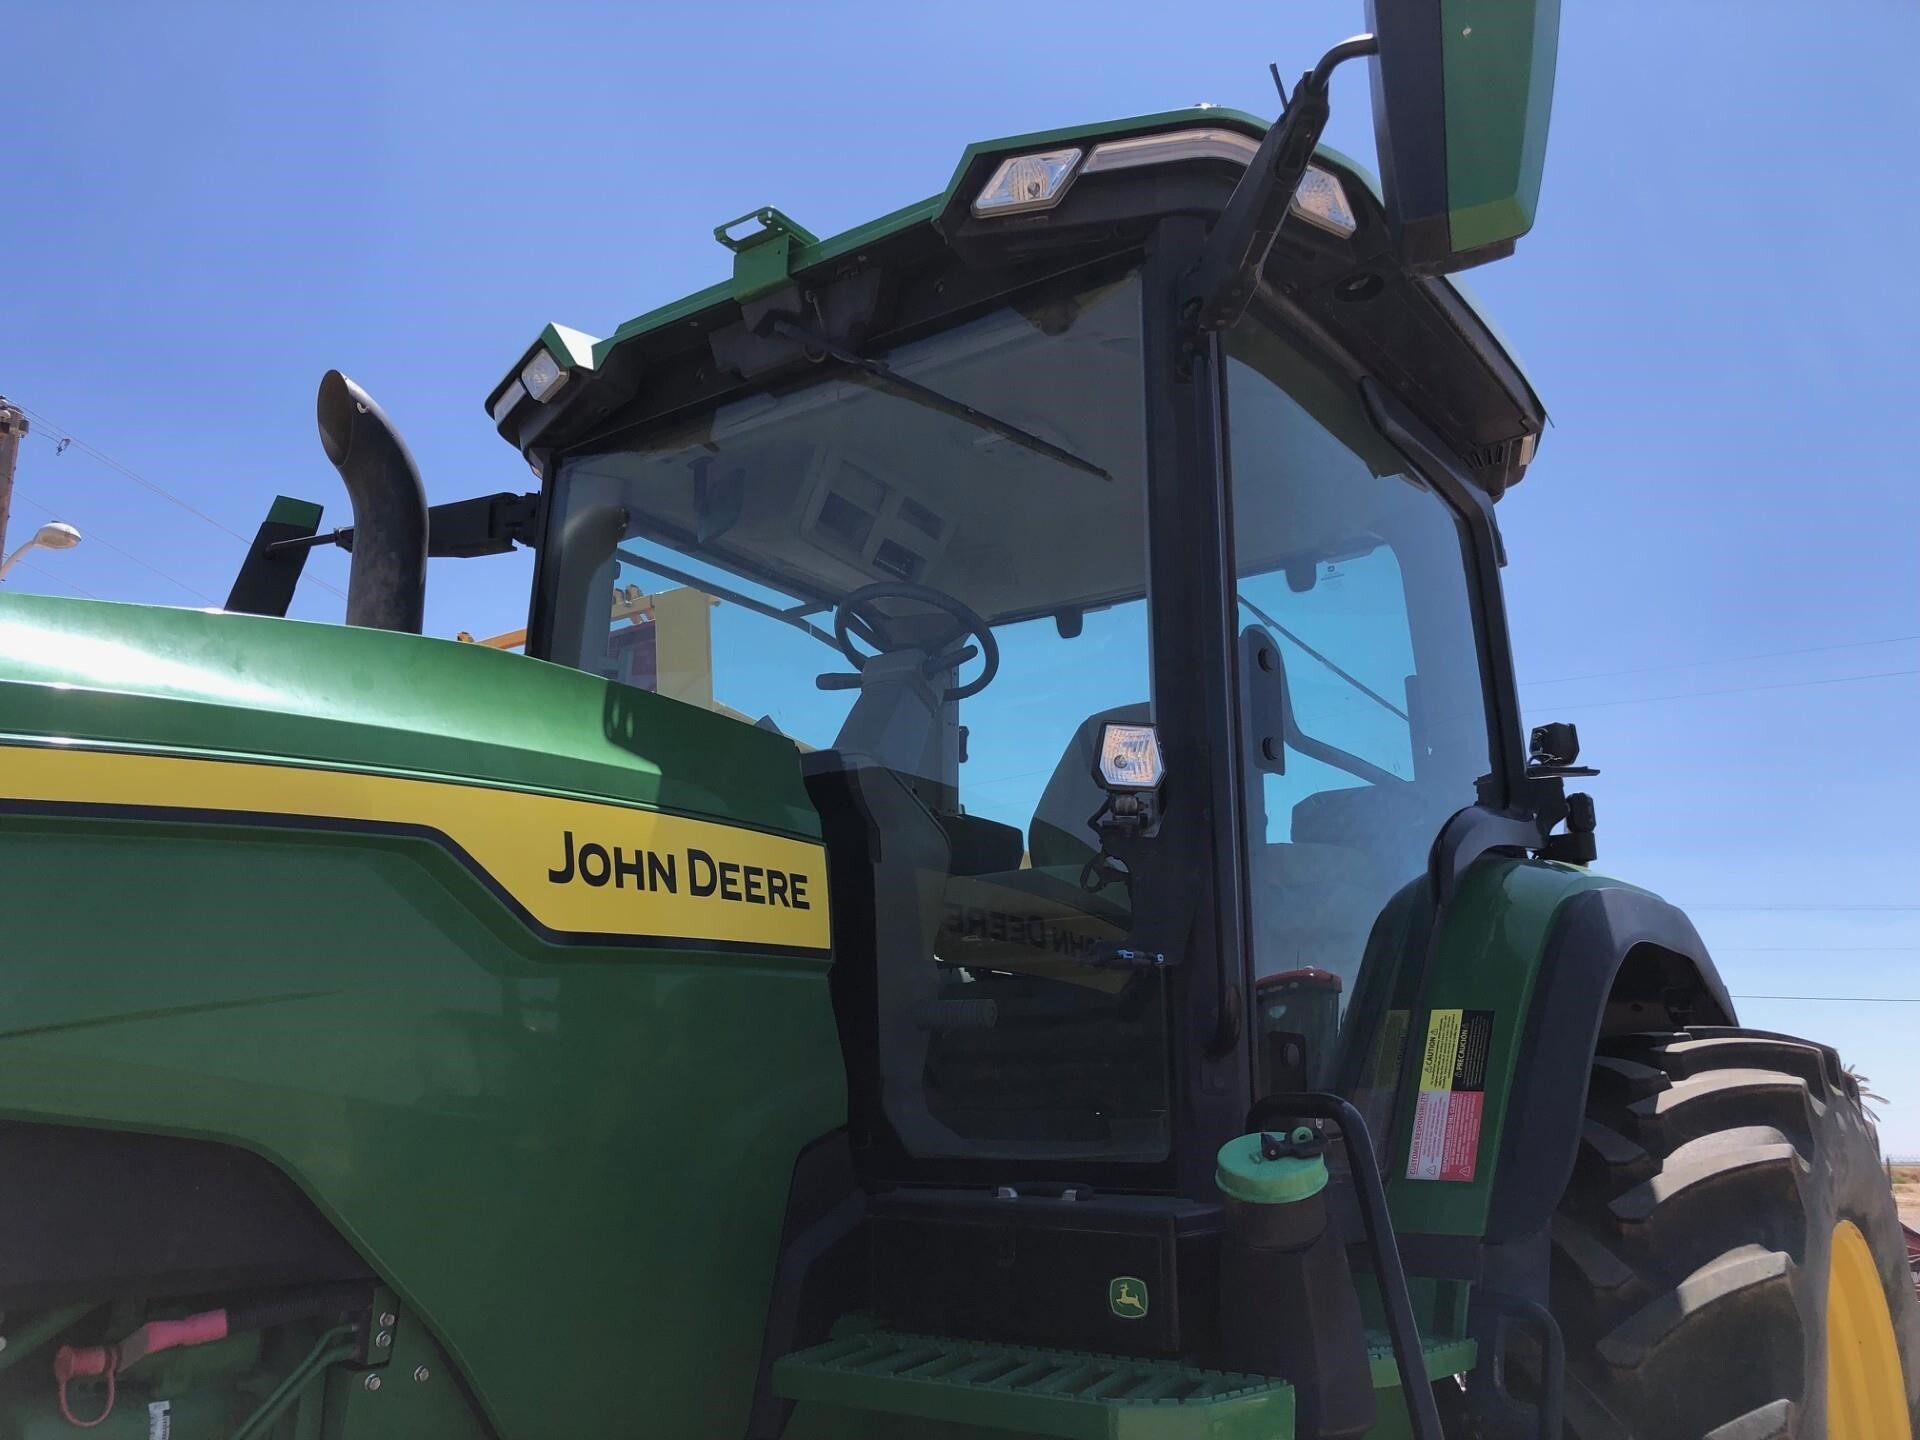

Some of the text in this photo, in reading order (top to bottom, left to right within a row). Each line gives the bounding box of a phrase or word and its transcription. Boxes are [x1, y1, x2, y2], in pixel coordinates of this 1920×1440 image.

[548, 831, 810, 910] JOHN DEERE
[1427, 1036, 1436, 1066] CAUTION
[1456, 1029, 1468, 1071] PRECAUCIÓN
